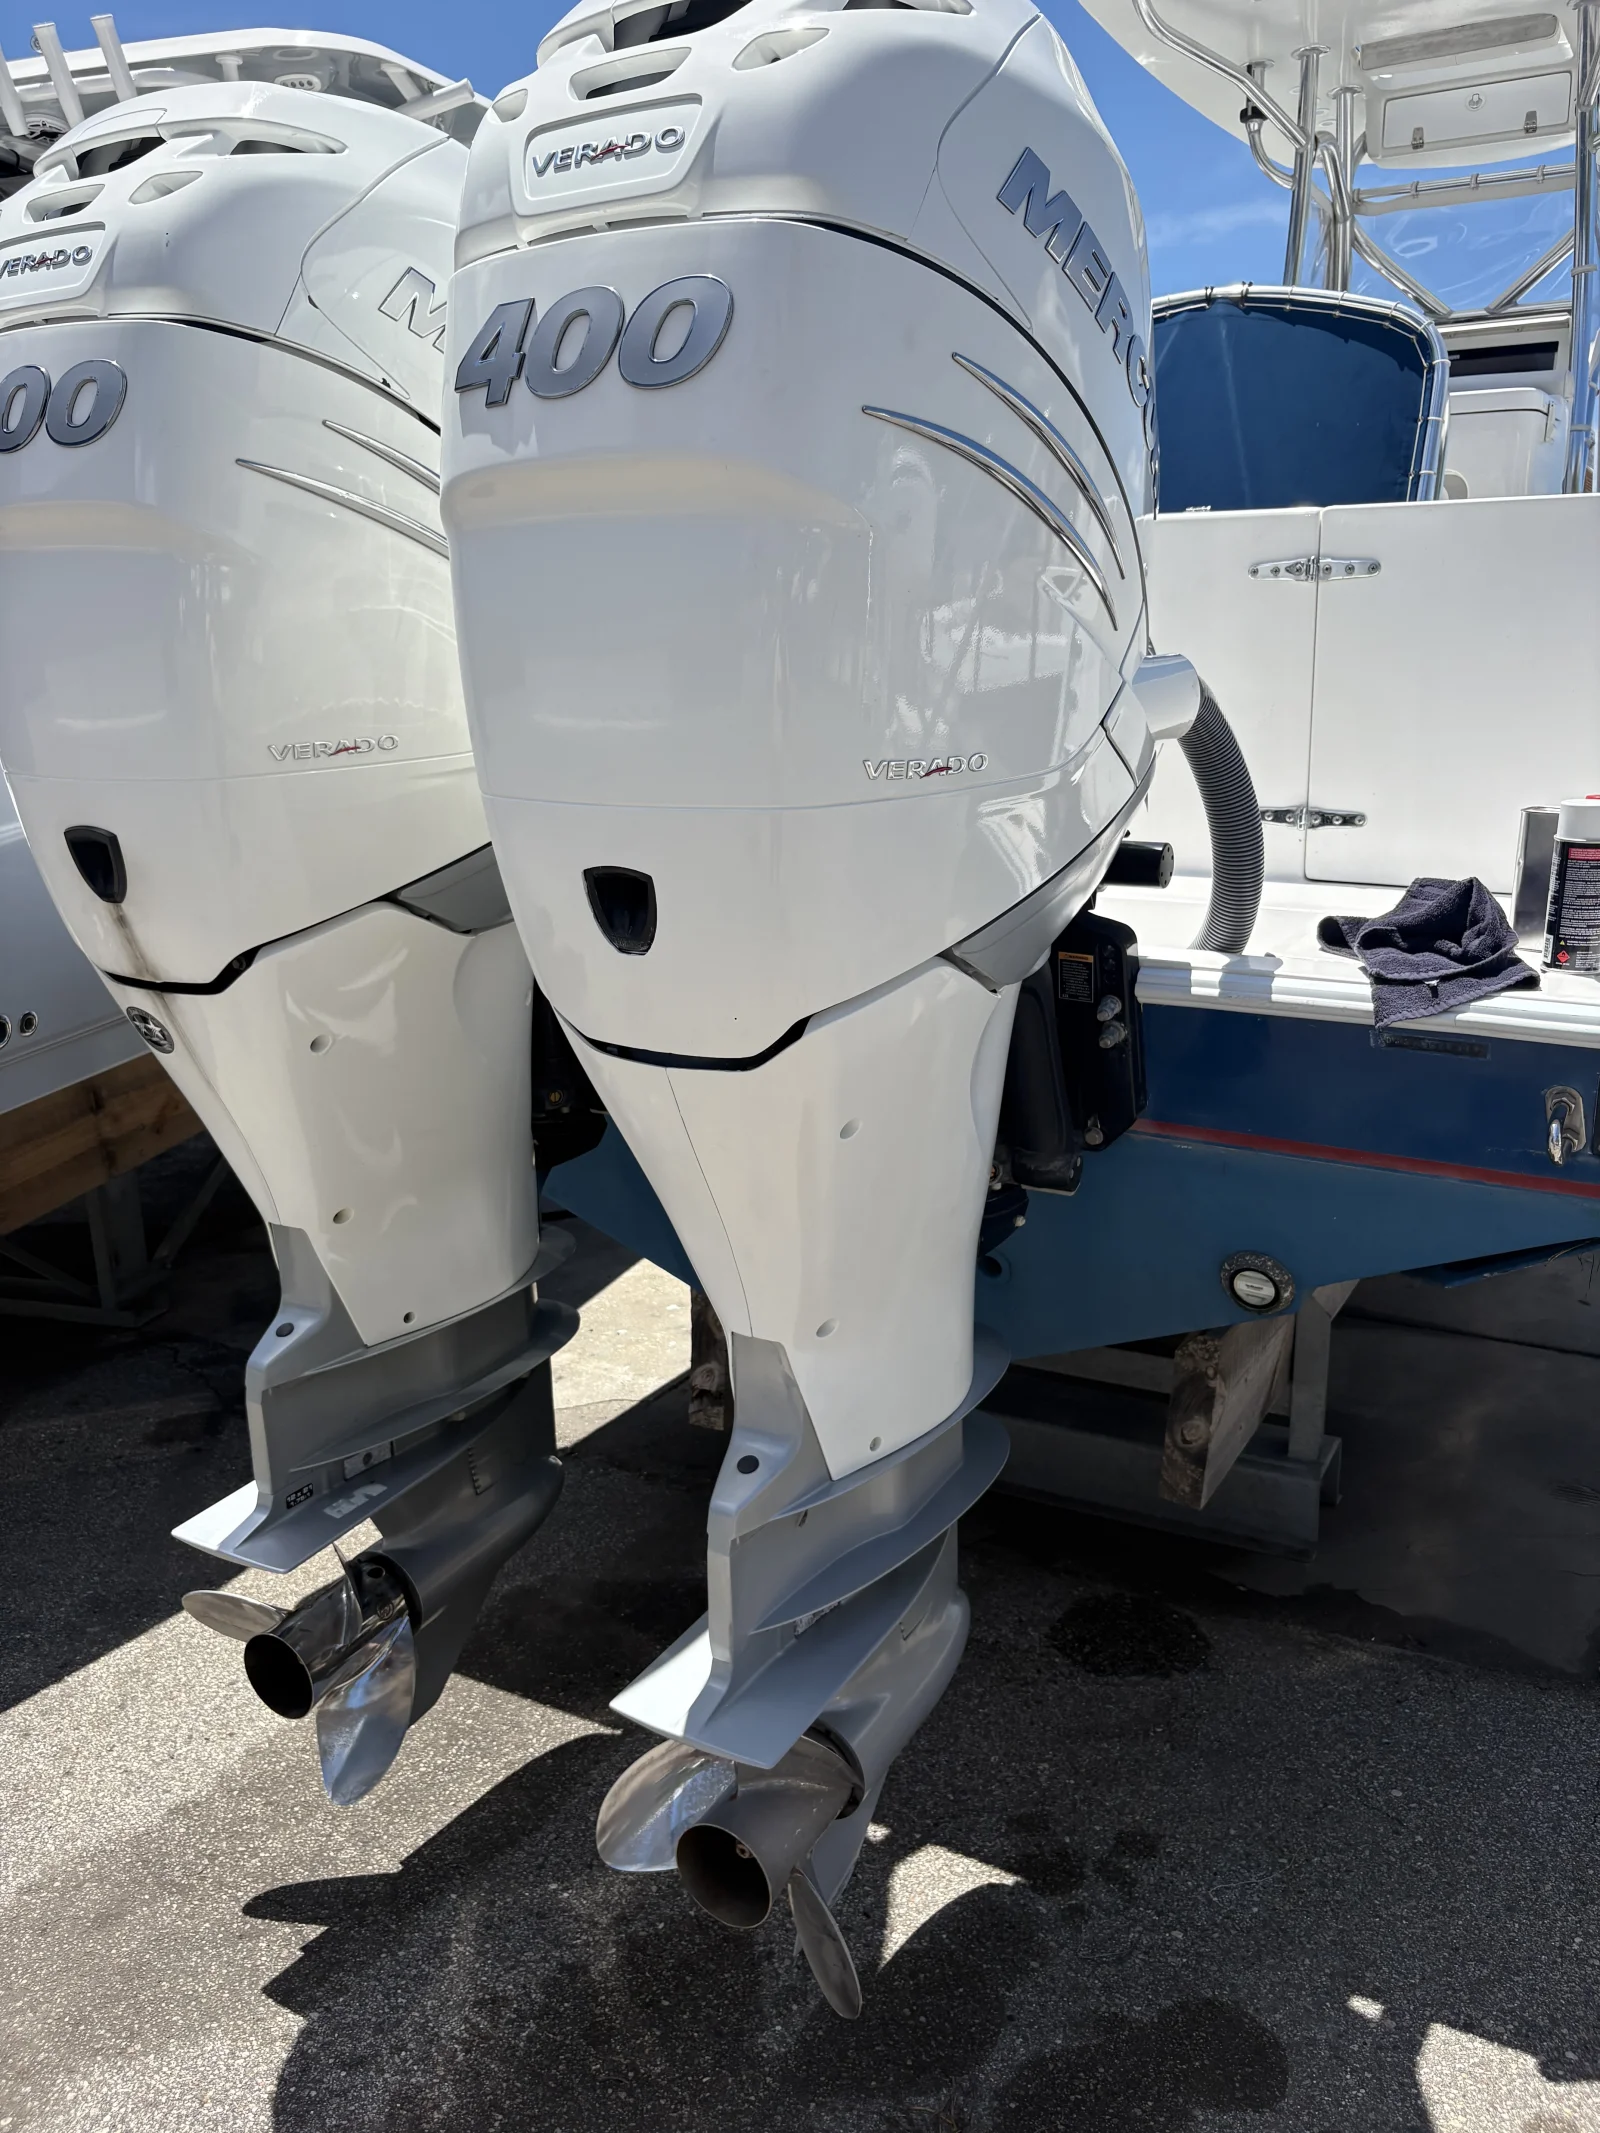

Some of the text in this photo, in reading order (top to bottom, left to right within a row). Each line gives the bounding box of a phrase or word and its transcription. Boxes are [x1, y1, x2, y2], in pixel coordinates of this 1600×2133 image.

[532, 126, 686, 175] VERADO
[455, 273, 734, 408] 400
[267, 734, 399, 761] VERADO
[863, 752, 989, 780] VERADO
